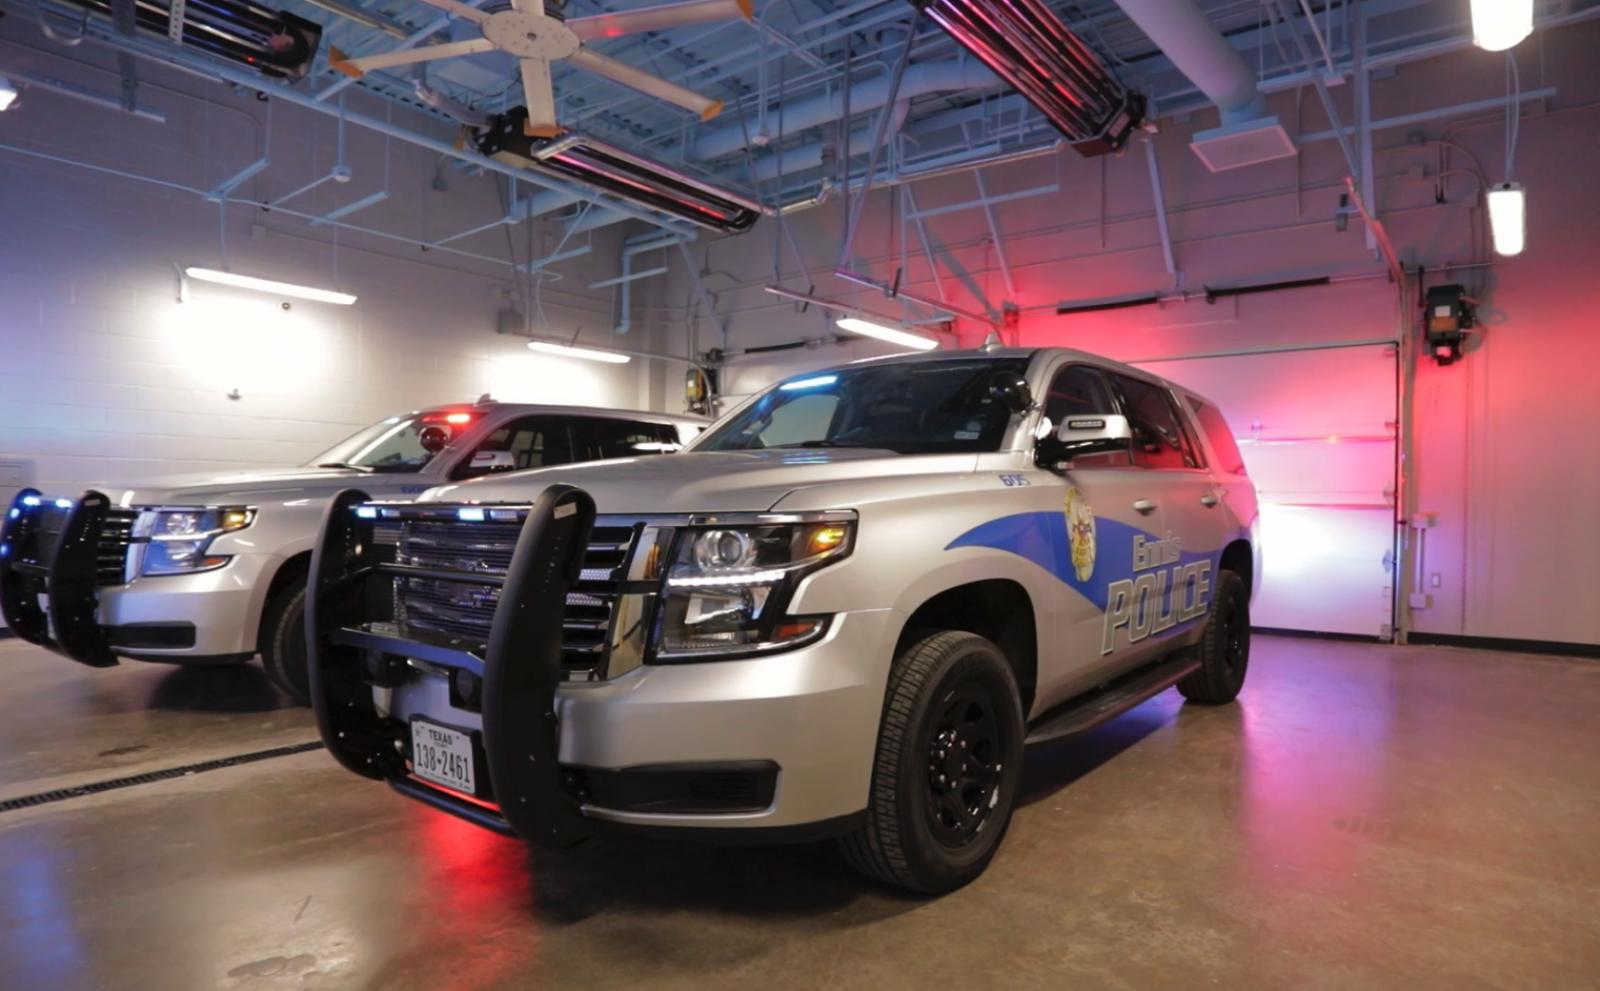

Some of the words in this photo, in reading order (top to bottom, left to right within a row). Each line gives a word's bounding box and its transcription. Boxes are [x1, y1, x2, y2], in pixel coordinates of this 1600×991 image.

[1132, 530, 1181, 572] Ennis
[1101, 559, 1211, 656] POLICE
[428, 729, 453, 746] TEXAS
